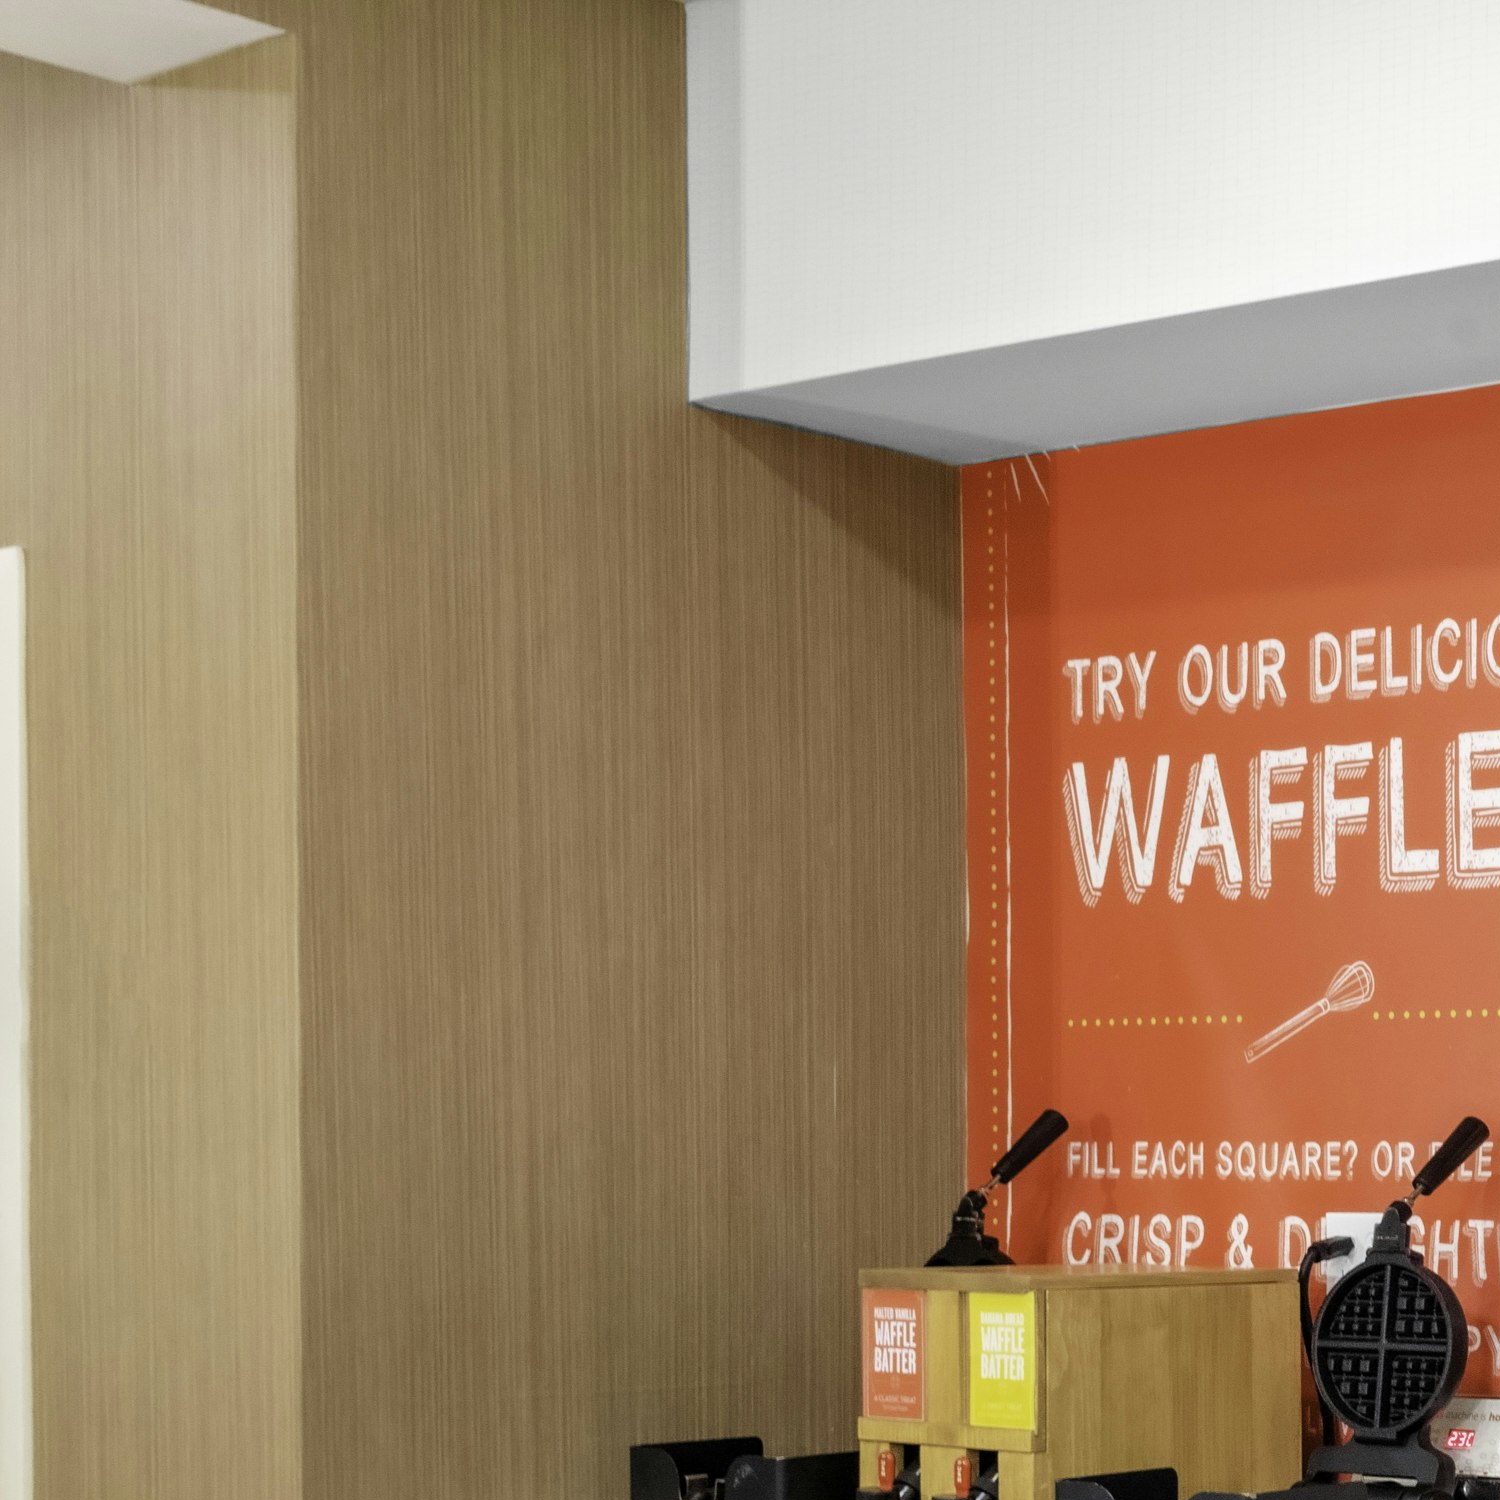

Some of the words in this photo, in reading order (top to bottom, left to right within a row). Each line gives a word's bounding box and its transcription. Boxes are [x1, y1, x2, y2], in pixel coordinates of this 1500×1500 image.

[1062, 650, 1157, 724] TRY
[1178, 638, 1288, 714] OUR
[1067, 1140, 1121, 1179] FILL
[1131, 1140, 1204, 1180] EACH
[1216, 1139, 1358, 1182] SQUARE?
[1371, 1139, 1416, 1182] OR
[1429, 1141, 1494, 1183] LE
[1062, 1210, 1205, 1269] CRISP
[1225, 1212, 1255, 1270] &
[874, 1319, 917, 1348] WAFFLE
[979, 1326, 1025, 1354] WAFFLE
[874, 1346, 917, 1375] BATTER
[980, 1353, 1025, 1381] BATTER
